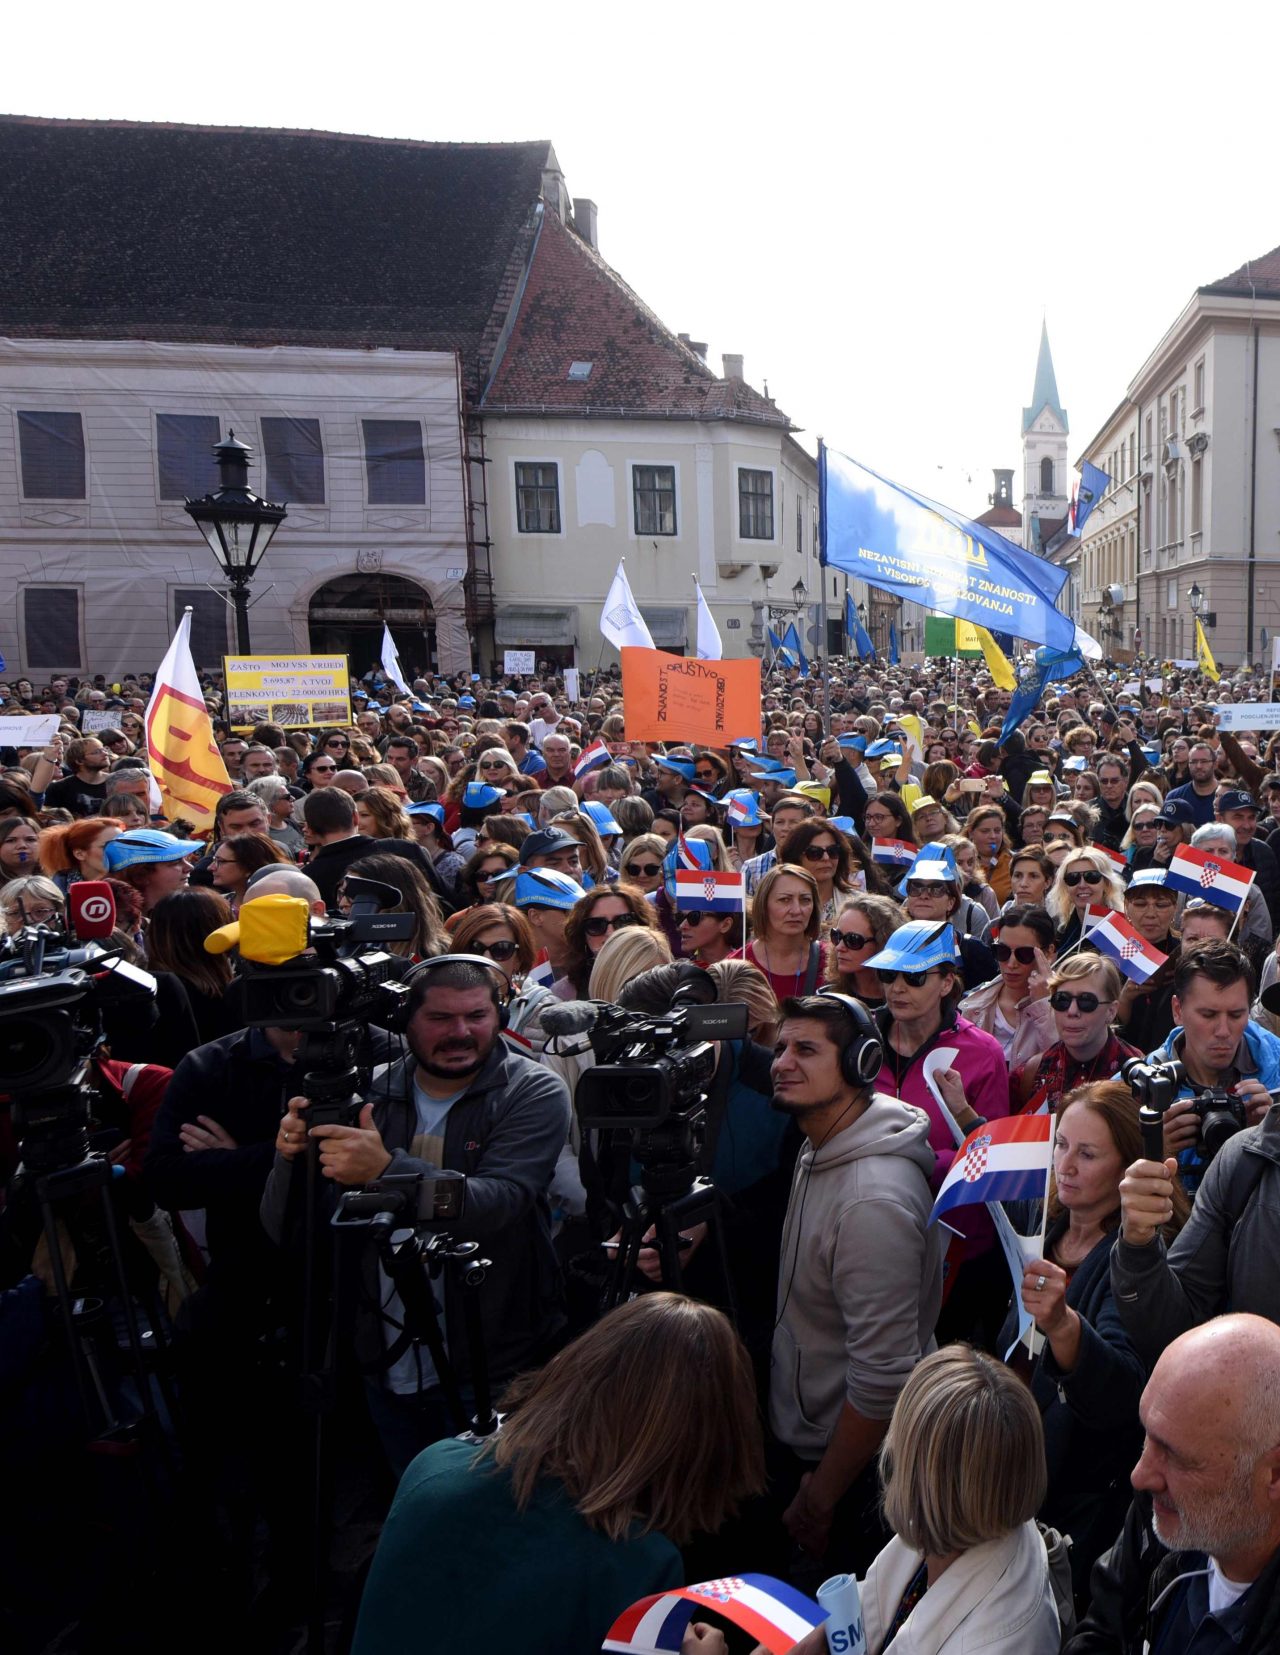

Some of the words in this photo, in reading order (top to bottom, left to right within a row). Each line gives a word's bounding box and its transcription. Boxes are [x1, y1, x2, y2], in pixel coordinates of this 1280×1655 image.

[858, 548, 920, 573] NEZAVISNI
[978, 578, 1037, 606] ZNANOSTI
[230, 663, 261, 671] ZAŠTO
[311, 661, 344, 669] VRIJEDI
[310, 678, 332, 686] TVOJ
[667, 661, 718, 679] DRUŠTVO
[658, 668, 668, 722] ZNANOST
[715, 677, 725, 731] OBRAZOVANJE
